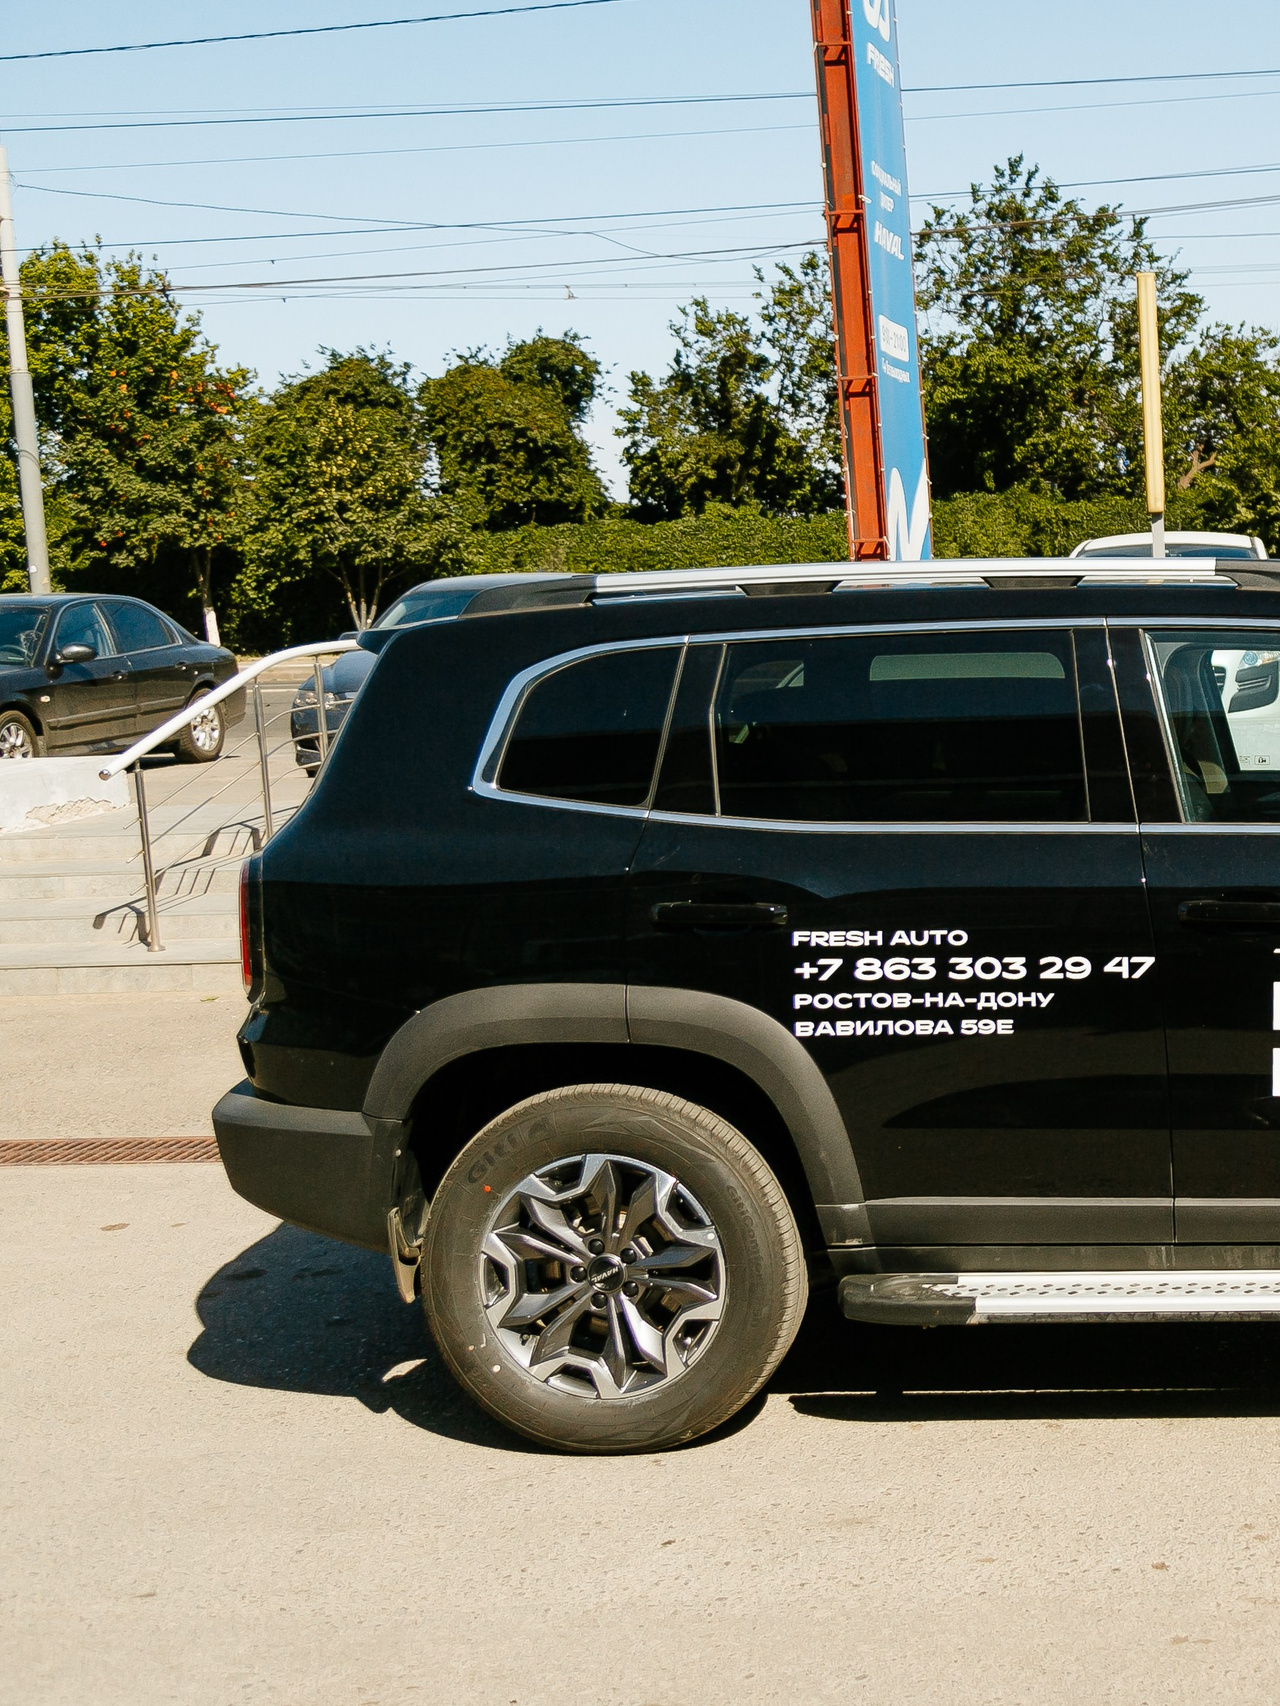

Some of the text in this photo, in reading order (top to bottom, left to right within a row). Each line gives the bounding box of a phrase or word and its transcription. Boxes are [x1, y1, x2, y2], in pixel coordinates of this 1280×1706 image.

[874, 220, 905, 260] HAVAL
[792, 930, 969, 946] FRESH AUTO
[794, 956, 1156, 981] +7 863 303 29 47
[793, 992, 1055, 1010] РОСТОВ-НА-ДОНУ
[794, 1020, 954, 1037] ВАВИЛОВА
[591, 1266, 619, 1283] HAVAL
